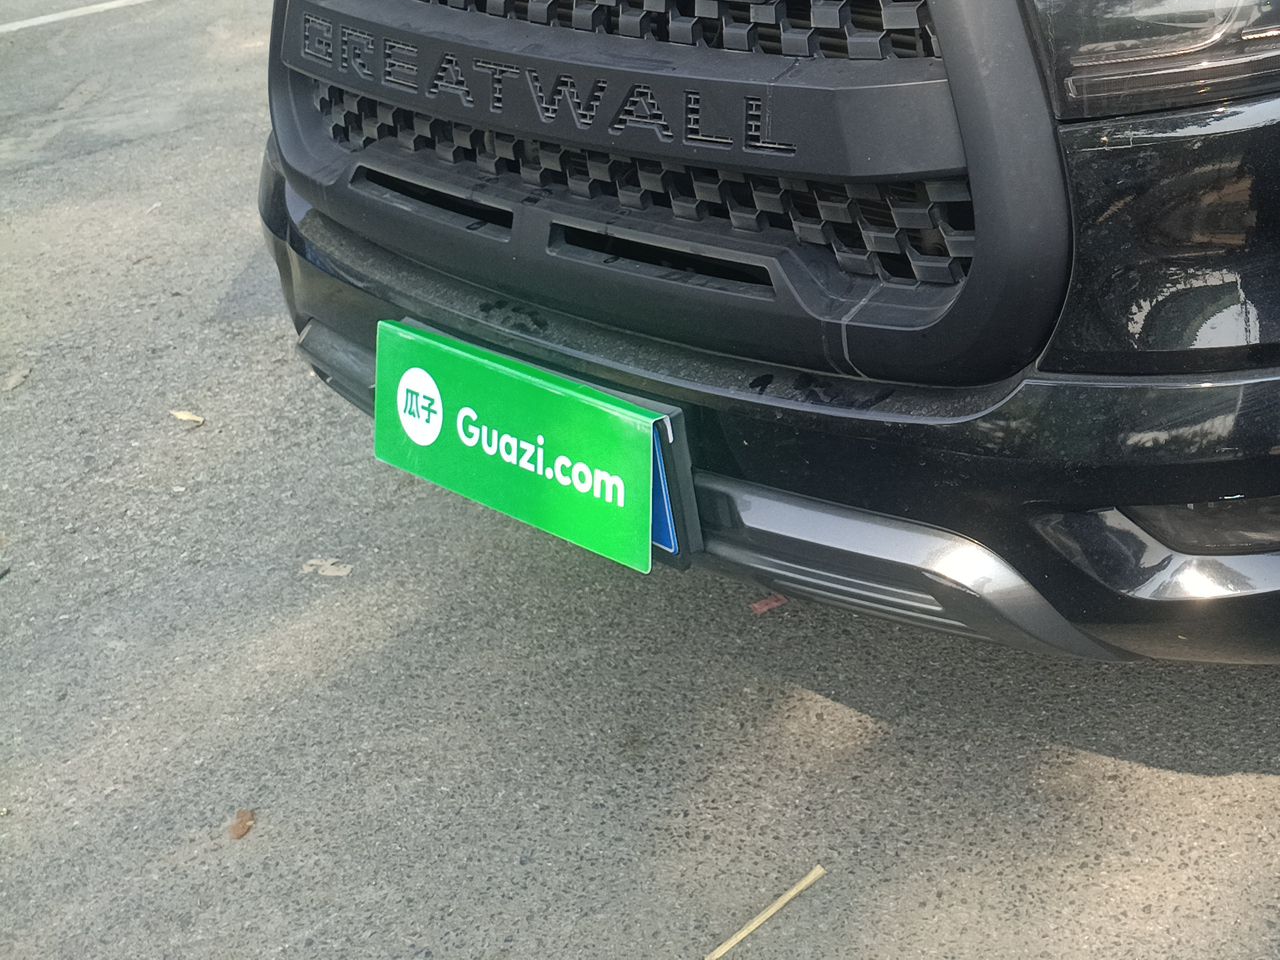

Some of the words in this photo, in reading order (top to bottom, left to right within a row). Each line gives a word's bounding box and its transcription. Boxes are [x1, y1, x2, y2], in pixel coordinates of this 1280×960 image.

[302, 12, 797, 155] GREATWALL
[403, 387, 438, 424] 瓜子
[456, 406, 625, 508] Guazi.com
